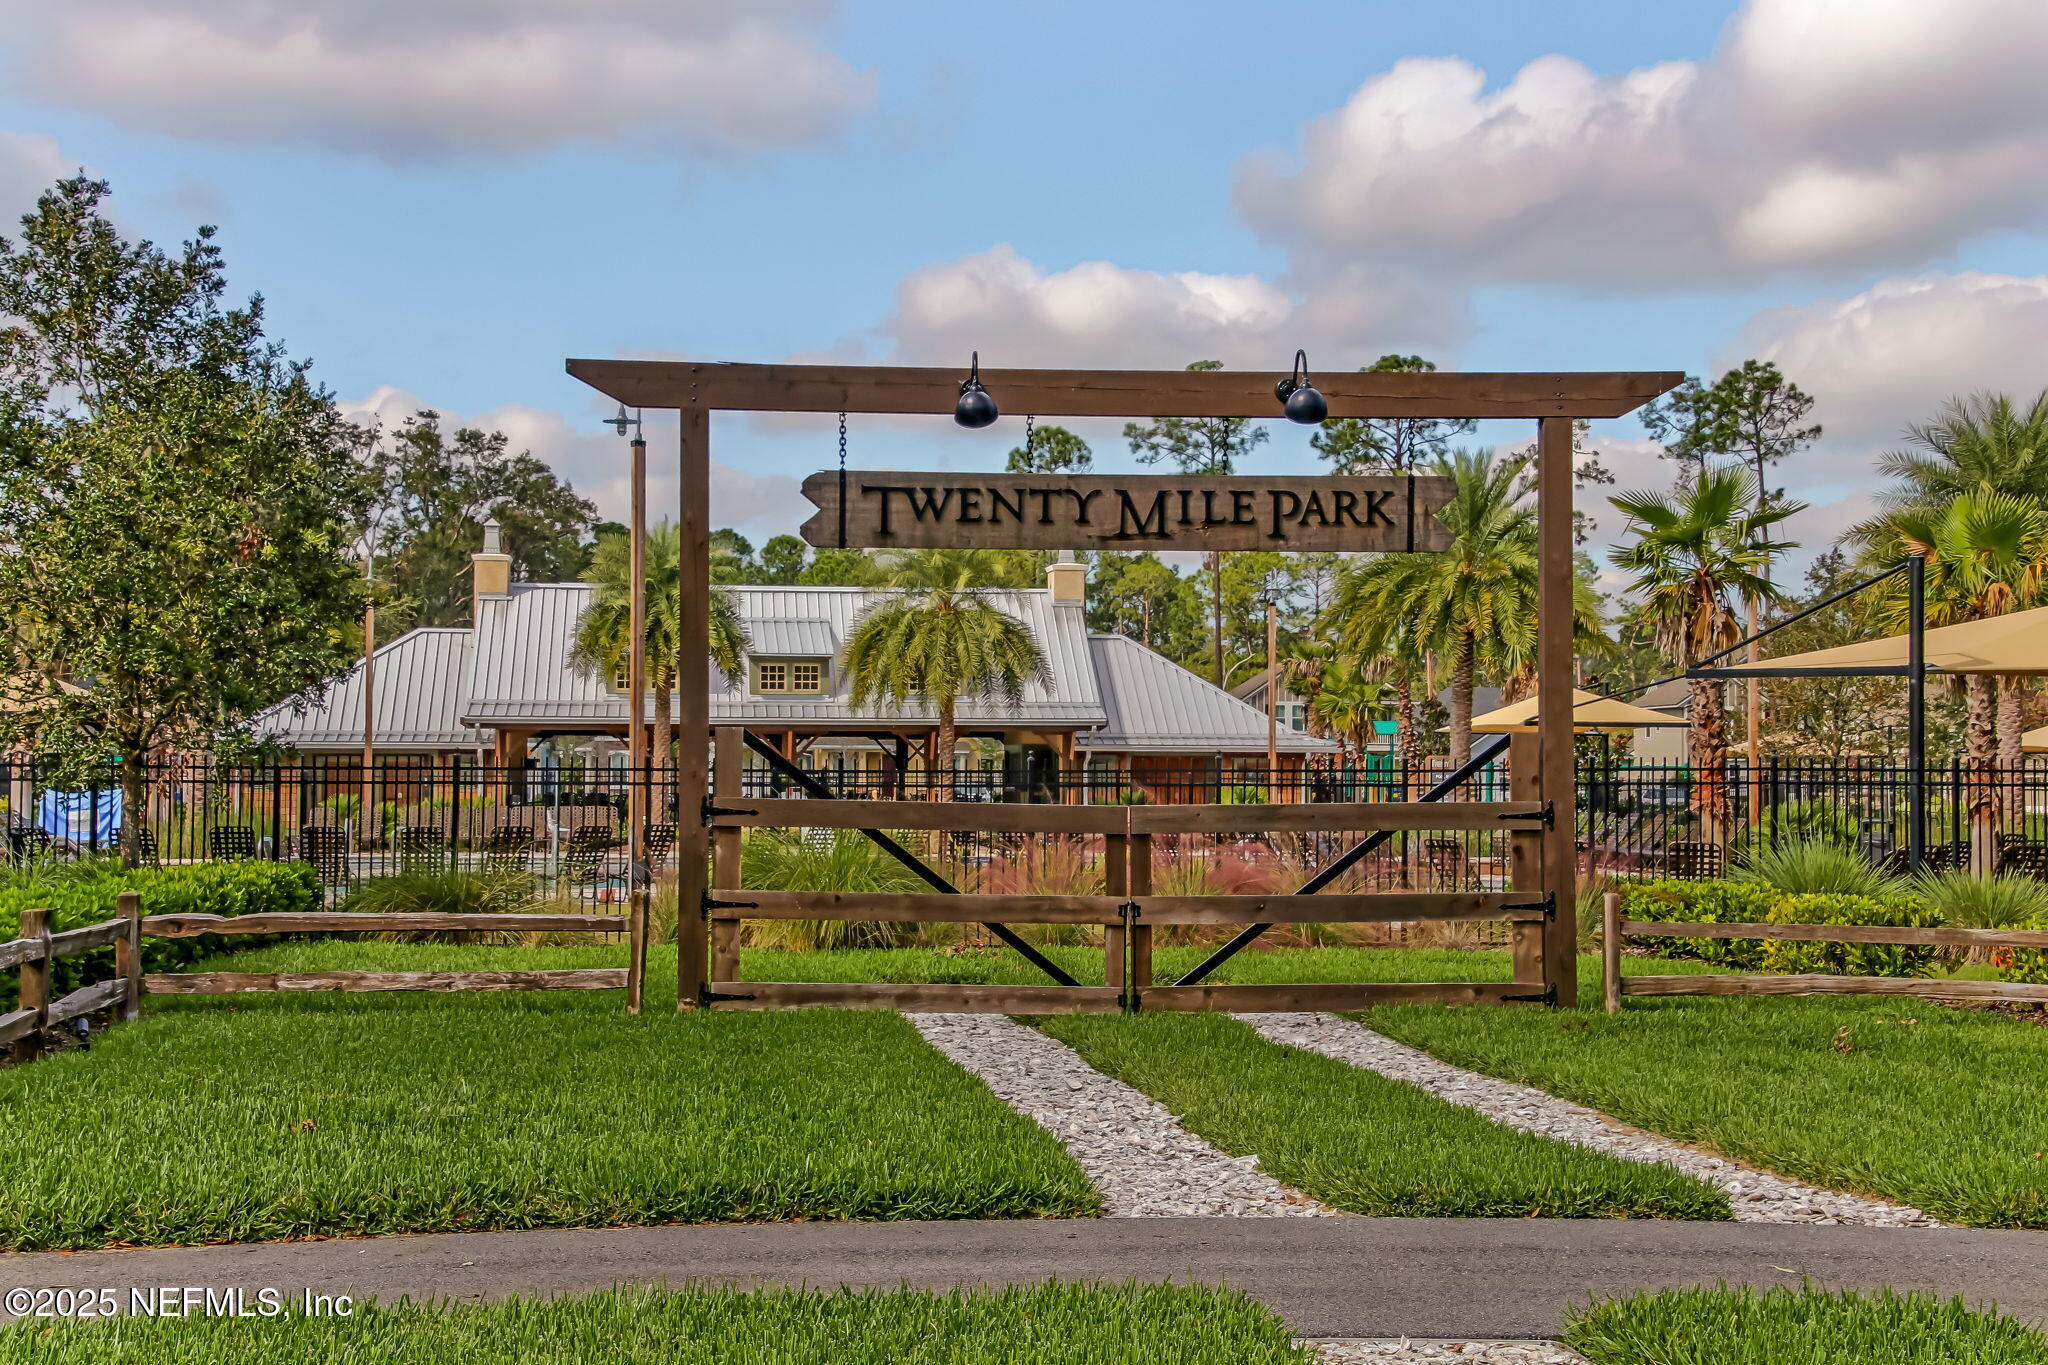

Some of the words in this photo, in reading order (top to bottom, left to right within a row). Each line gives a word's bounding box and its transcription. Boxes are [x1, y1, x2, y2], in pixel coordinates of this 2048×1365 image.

[860, 484, 1103, 534] TWENTY
[1114, 488, 1256, 537] MILE
[1267, 489, 1396, 539] PARK
